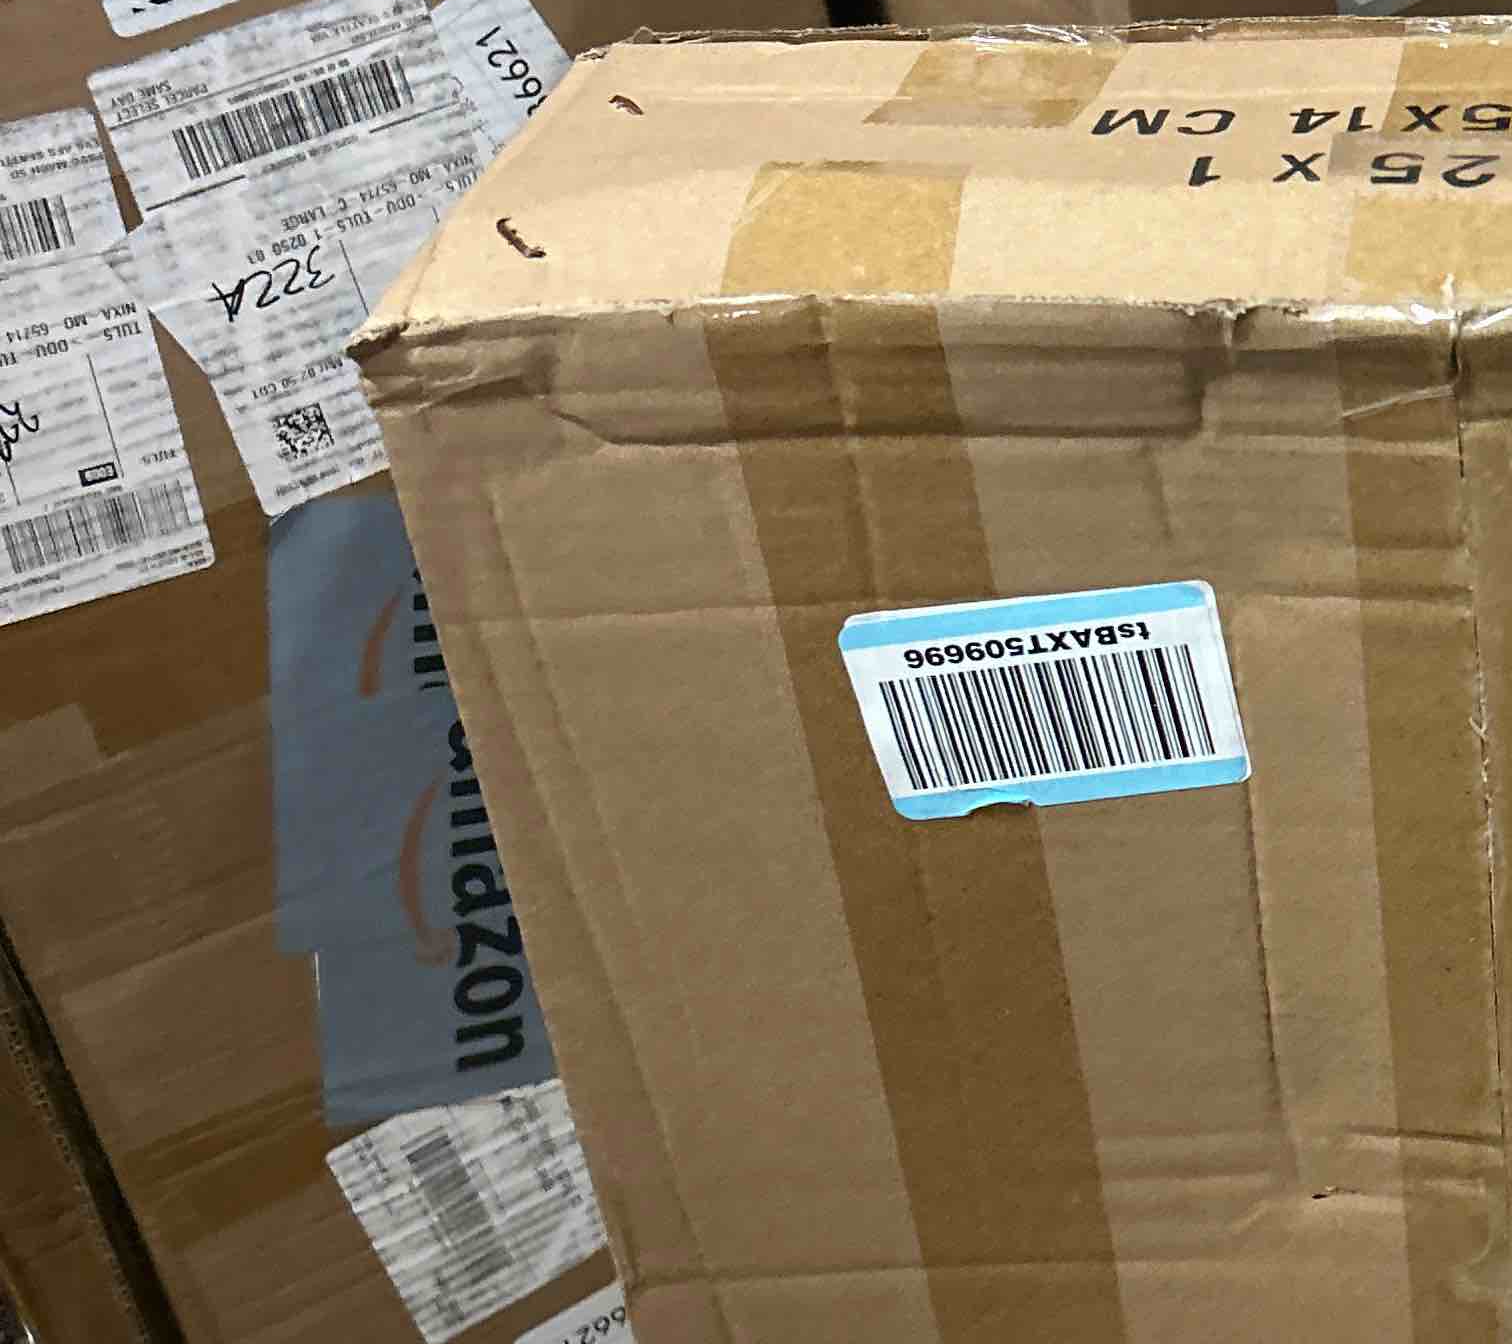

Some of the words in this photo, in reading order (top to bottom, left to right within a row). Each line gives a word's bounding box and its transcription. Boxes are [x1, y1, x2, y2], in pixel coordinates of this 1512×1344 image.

[1090, 108, 1237, 135] CM
[1187, 155, 1222, 187] 1
[1272, 152, 1327, 183] X
[1370, 151, 1501, 188] 25
[280, 204, 326, 232] LARGE
[63, 313, 88, 330] MO
[100, 301, 137, 321] NIXA
[903, 621, 1152, 670] tsBAXT509696
